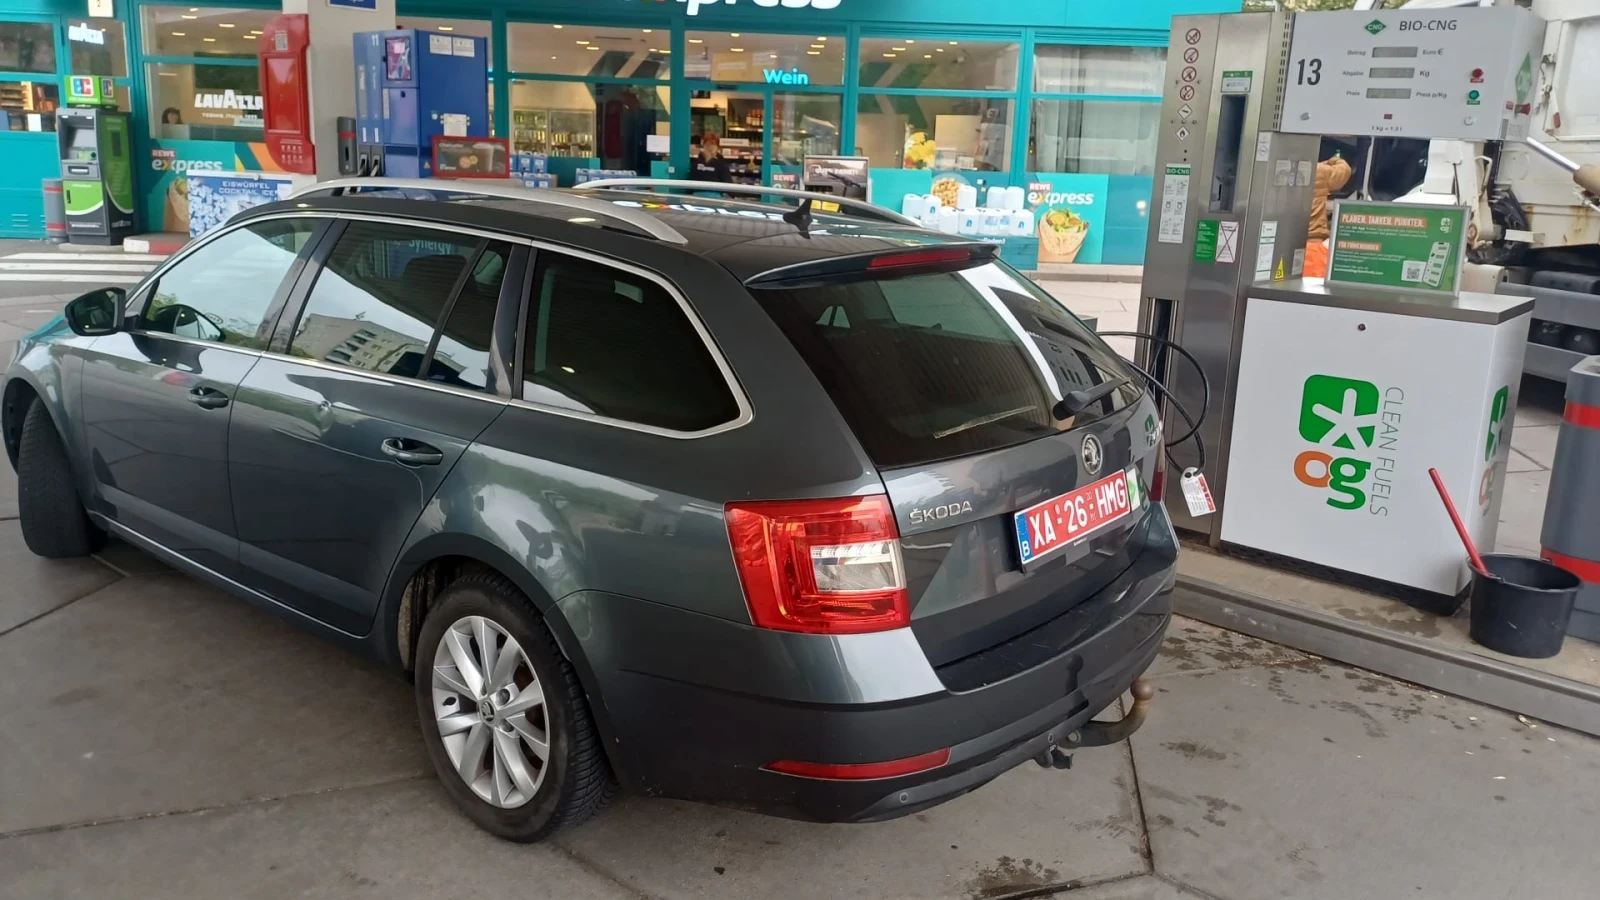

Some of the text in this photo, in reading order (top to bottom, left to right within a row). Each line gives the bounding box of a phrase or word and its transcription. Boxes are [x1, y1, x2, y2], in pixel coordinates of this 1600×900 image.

[1399, 20, 1458, 31] BIO-CNG
[763, 68, 809, 85] Wein
[1296, 58, 1322, 86] 13
[152, 159, 223, 174] express
[773, 174, 795, 182] REWE
[1029, 182, 1051, 191] REWE
[1027, 191, 1095, 206] express
[1369, 386, 1405, 518] CLEAN FUELS
[909, 500, 973, 525] ŠKODA
[1021, 540, 1031, 557] B
